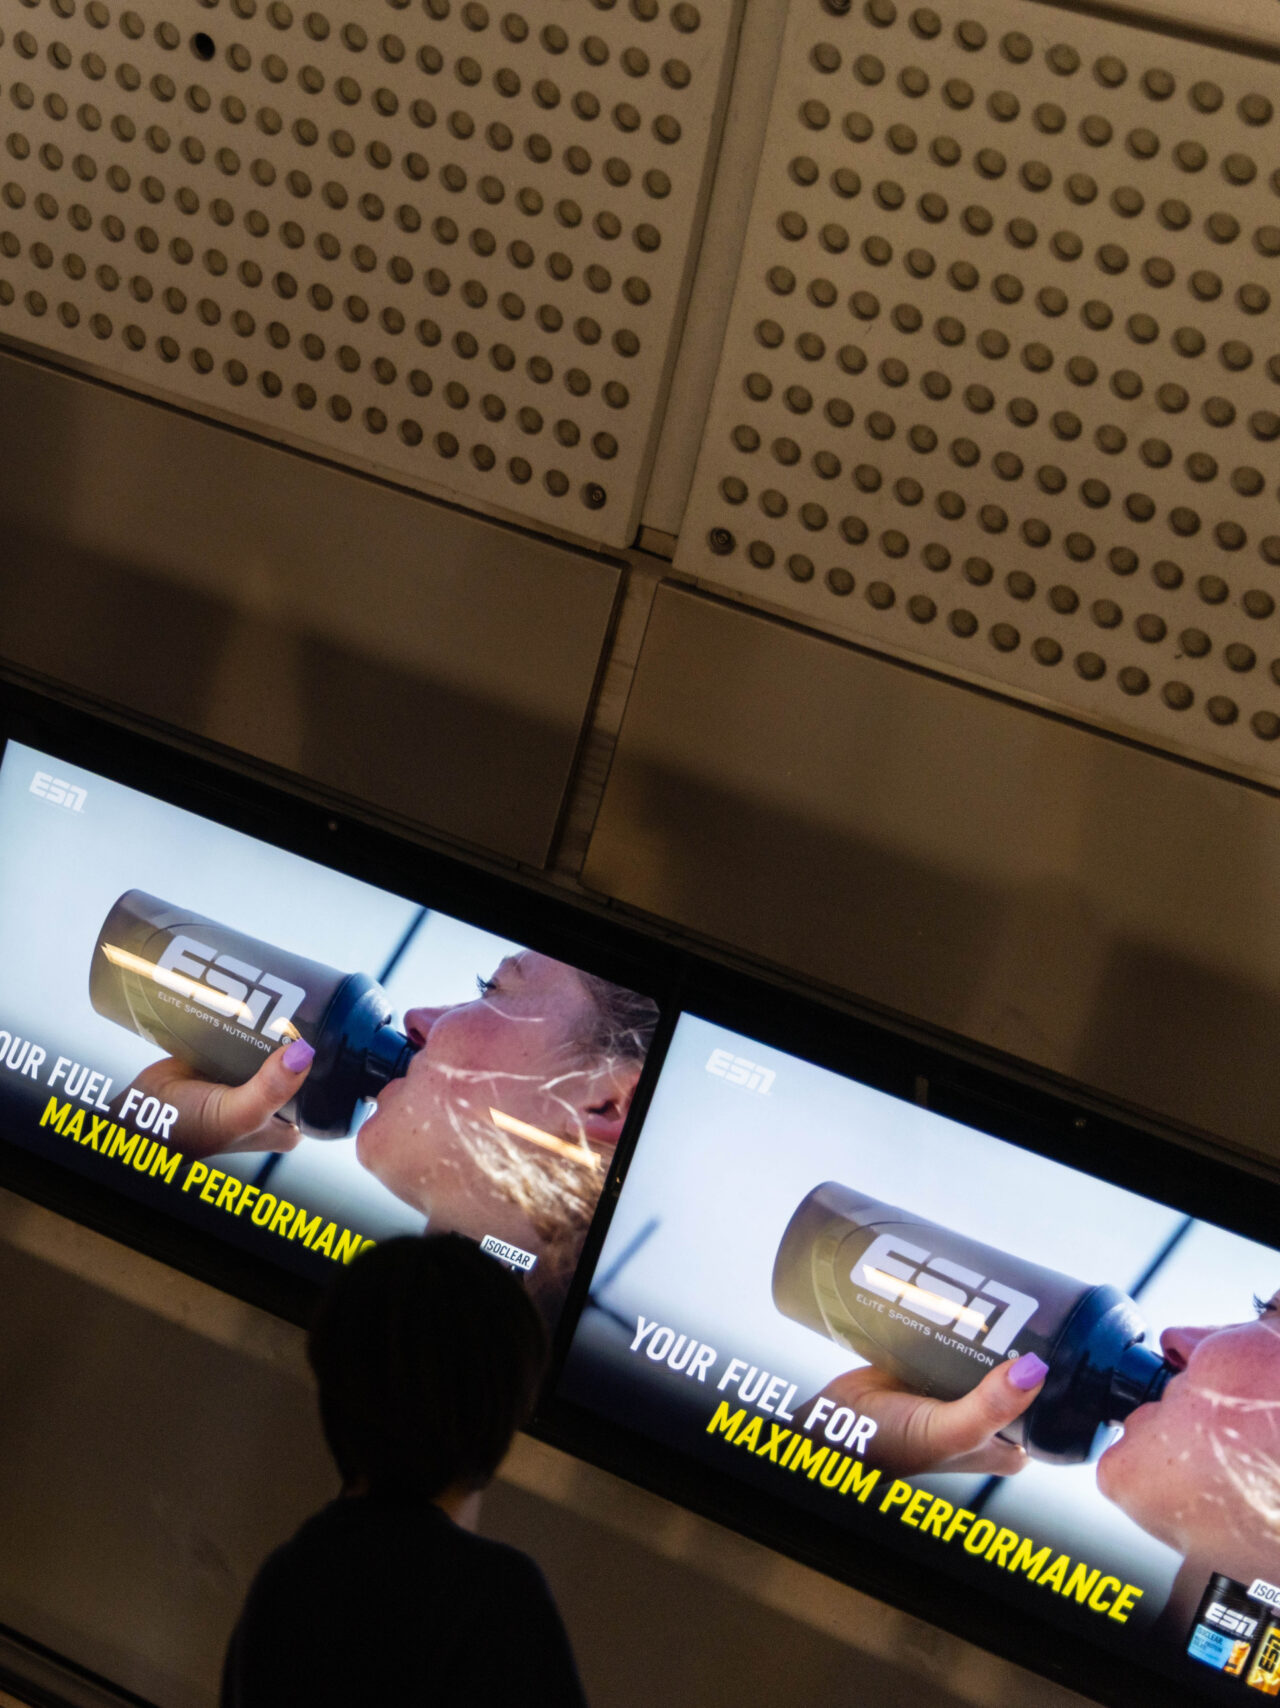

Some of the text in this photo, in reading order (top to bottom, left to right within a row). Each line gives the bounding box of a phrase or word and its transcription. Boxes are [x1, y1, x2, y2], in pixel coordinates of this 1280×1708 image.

[157, 991, 272, 1053] ELITE SPORTS NUTRITION
[38, 1095, 183, 1185] MAXIMUM
[47, 1055, 114, 1112] FUEL
[118, 1087, 179, 1140] FOR
[483, 1238, 531, 1267] ISOCLEAR
[856, 1293, 995, 1367] ELITE SPORTS NUTRITION
[628, 1315, 878, 1455] YOUR FUEL FOR
[705, 1400, 1145, 1623] MAXIMUM PERFORMANCE
